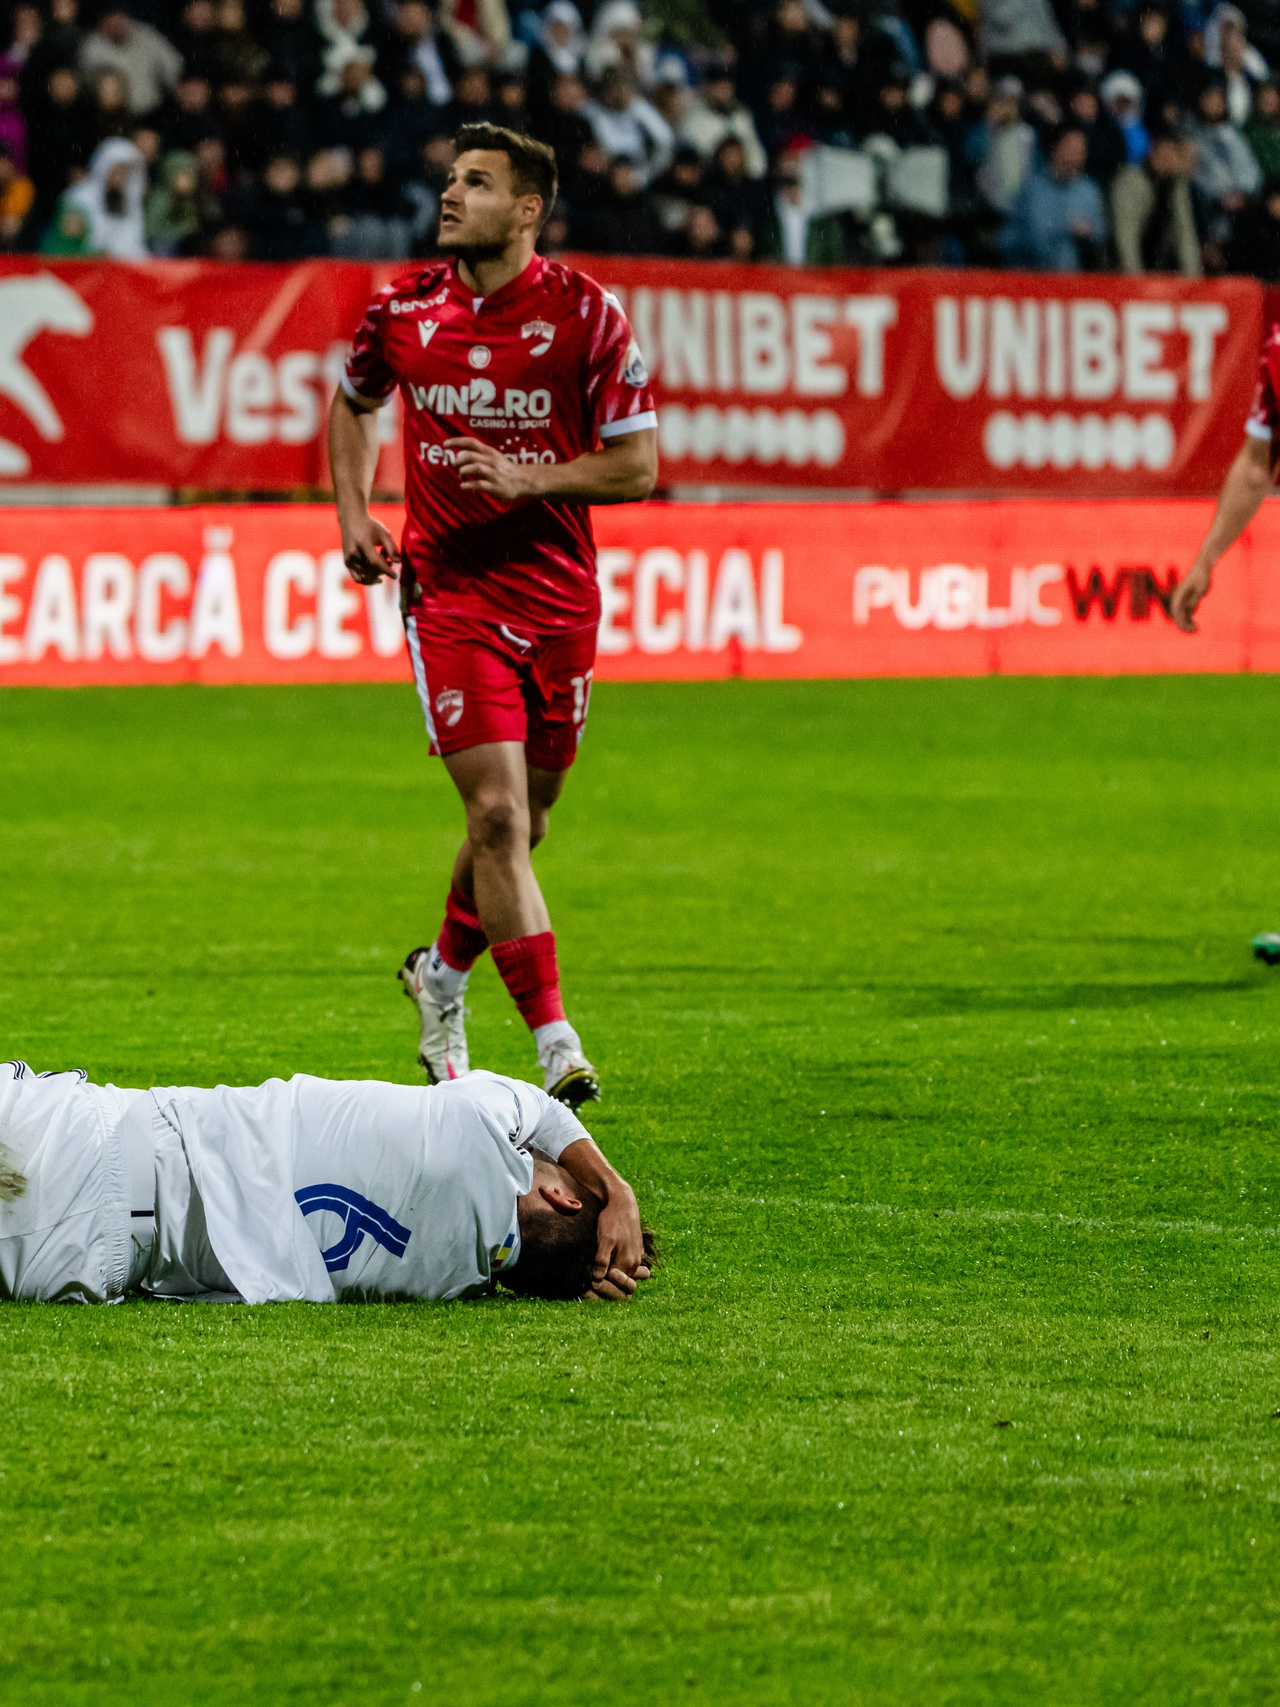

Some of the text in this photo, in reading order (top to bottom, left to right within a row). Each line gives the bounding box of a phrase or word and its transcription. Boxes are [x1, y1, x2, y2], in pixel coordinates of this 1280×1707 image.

[157, 325, 398, 446] Ves
[934, 295, 1228, 402] UNIBET
[408, 377, 552, 419] WIN2.RO
[469, 418, 508, 429] CASINO
